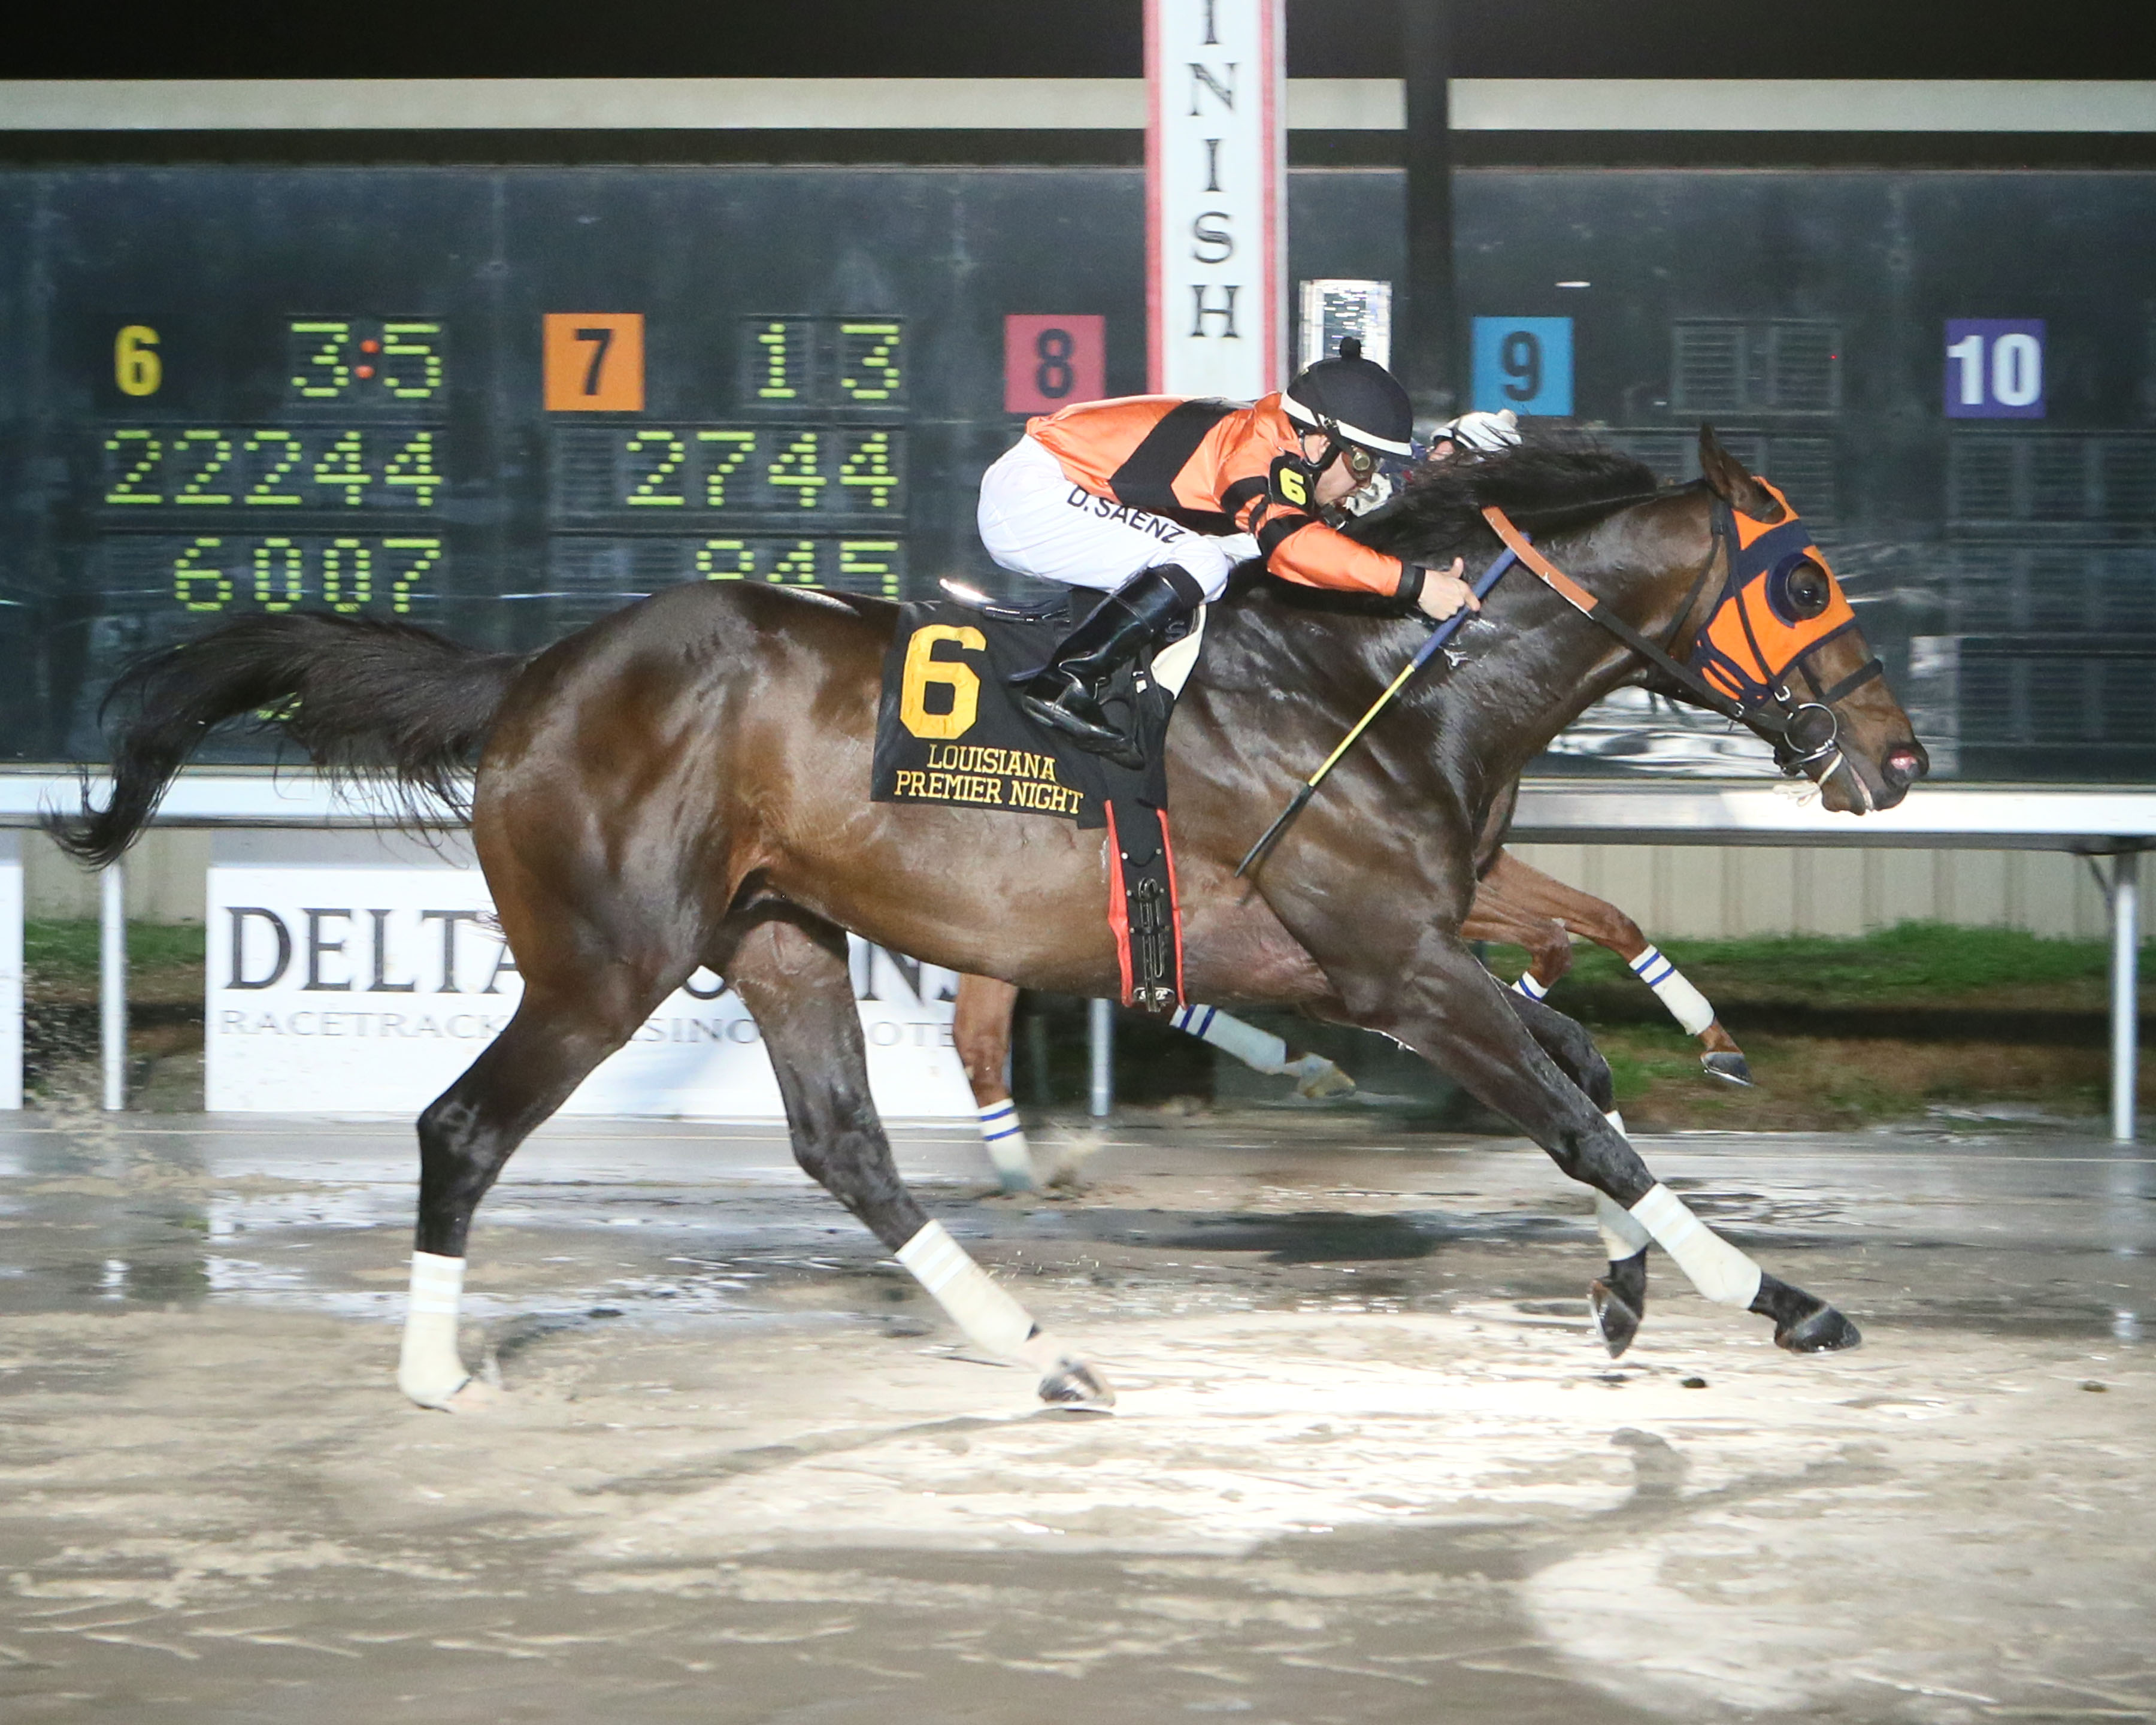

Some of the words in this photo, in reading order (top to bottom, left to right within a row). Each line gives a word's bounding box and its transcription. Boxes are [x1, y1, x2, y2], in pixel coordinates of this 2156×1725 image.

[114, 325, 162, 396] 6
[573, 328, 616, 396] 7
[1036, 328, 1073, 399] 8
[1502, 331, 1542, 401] 9
[1946, 333, 2041, 407] 10
[104, 429, 442, 506] 22244
[626, 431, 898, 507] 2744
[1279, 467, 1307, 506] 6
[174, 537, 442, 613] 6007
[900, 624, 987, 740] 6
[894, 770, 1003, 804] PREMIER
[1009, 780, 1083, 814] NIGHT
[927, 744, 1056, 781] LOUISIANA
[220, 1010, 510, 1039] RACETRACK
[630, 1018, 760, 1043] SINO
[868, 1021, 955, 1046] OTE
